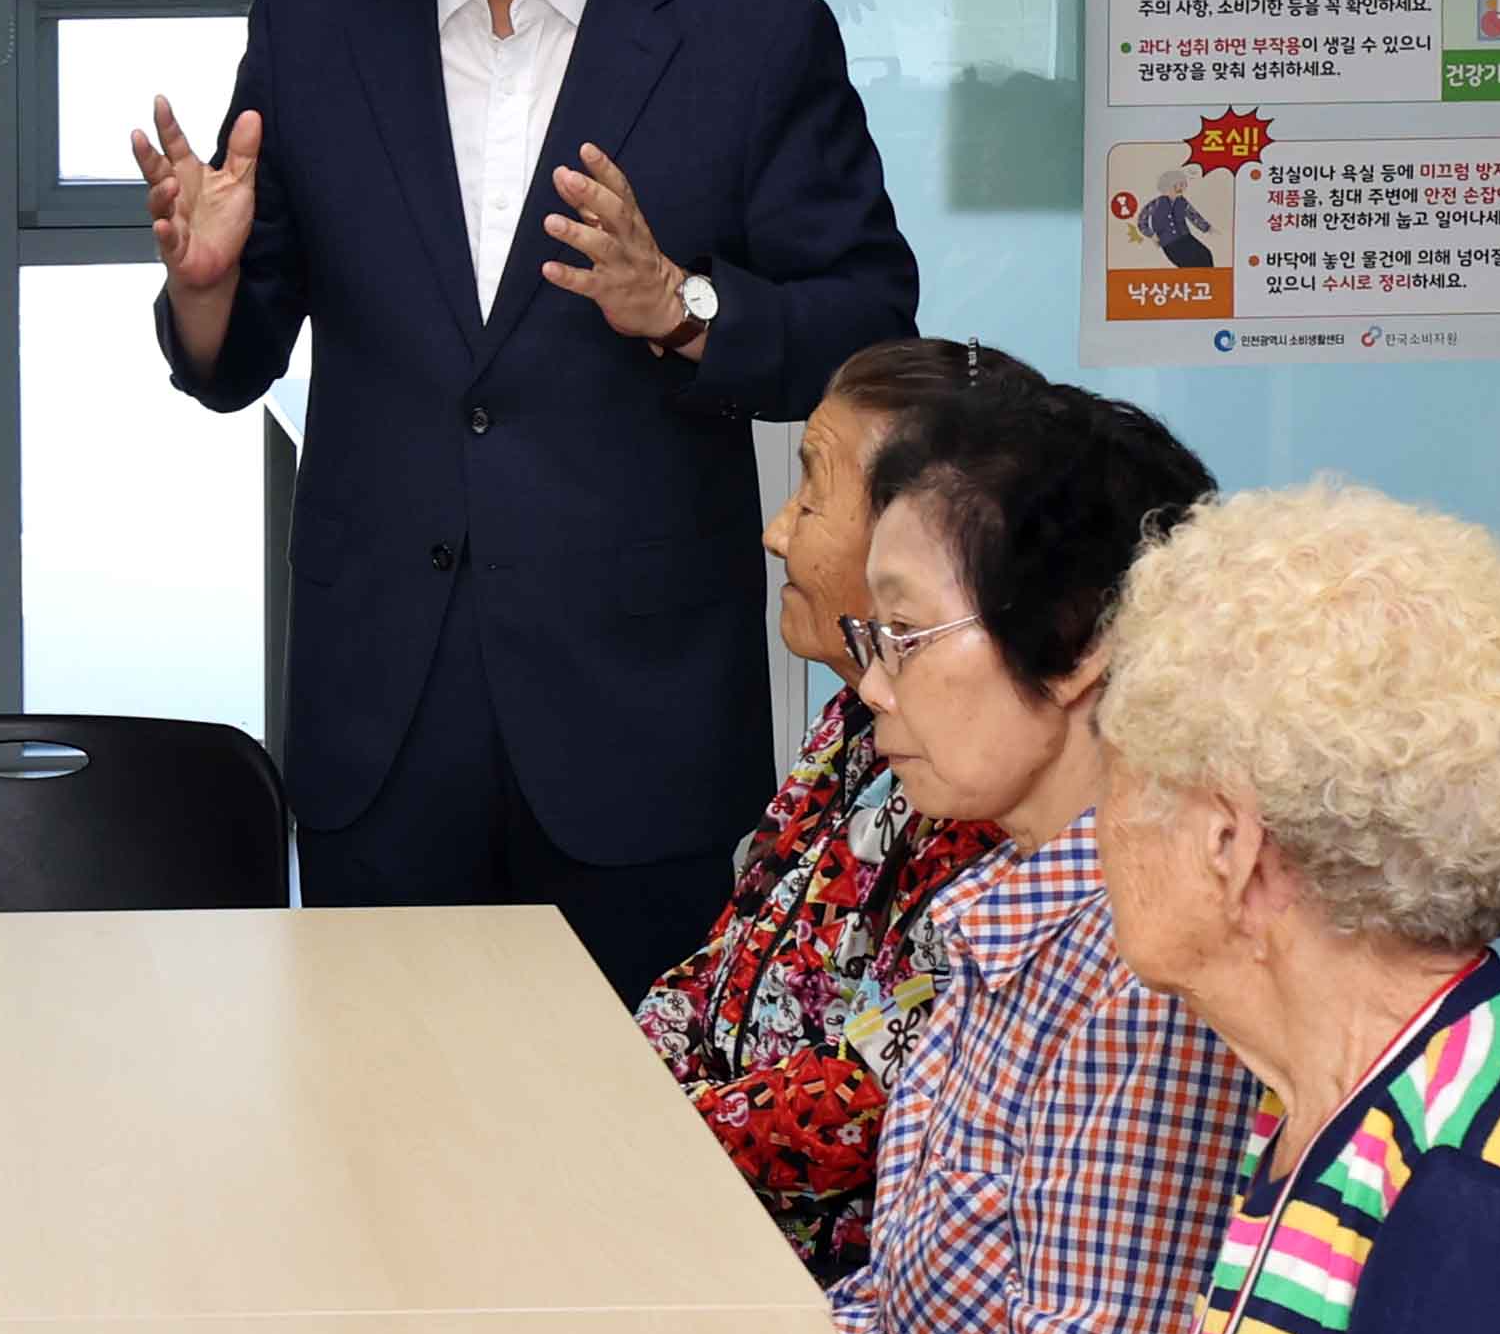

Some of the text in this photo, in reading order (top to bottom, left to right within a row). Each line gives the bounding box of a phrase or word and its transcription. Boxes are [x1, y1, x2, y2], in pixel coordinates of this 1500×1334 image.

[1137, 34, 1432, 58] 과다 섭취 하면 부작용이 생길 수 있으니
[1211, 60, 1246, 82] 맞춰
[1251, 59, 1342, 81] 섭취하세요.
[1201, 129, 1259, 155] 조심!
[1267, 164, 1337, 184] 침실이나
[1340, 163, 1375, 183] 욕실
[1379, 162, 1415, 182] 등에
[1419, 162, 1470, 182] 미끄럼
[1266, 188, 1324, 209] 제품을,
[1328, 187, 1363, 208] 침대
[1367, 186, 1419, 207] 주변에
[1423, 186, 1457, 206] 안전
[1266, 211, 1318, 232] 설치해
[1322, 210, 1391, 231] 안전하게
[1395, 210, 1430, 230] 눕고
[1265, 250, 1317, 270] 바닥에
[1321, 250, 1356, 270] 놓인
[1360, 249, 1412, 269] 물건에
[1416, 248, 1451, 266] 의해
[1128, 282, 1213, 306] 낙상사고
[1265, 272, 1468, 295] 있으니 수시로 정리하세요.
[1241, 334, 1288, 347] 인천광역시
[1385, 332, 1457, 347] 한국소비자원
